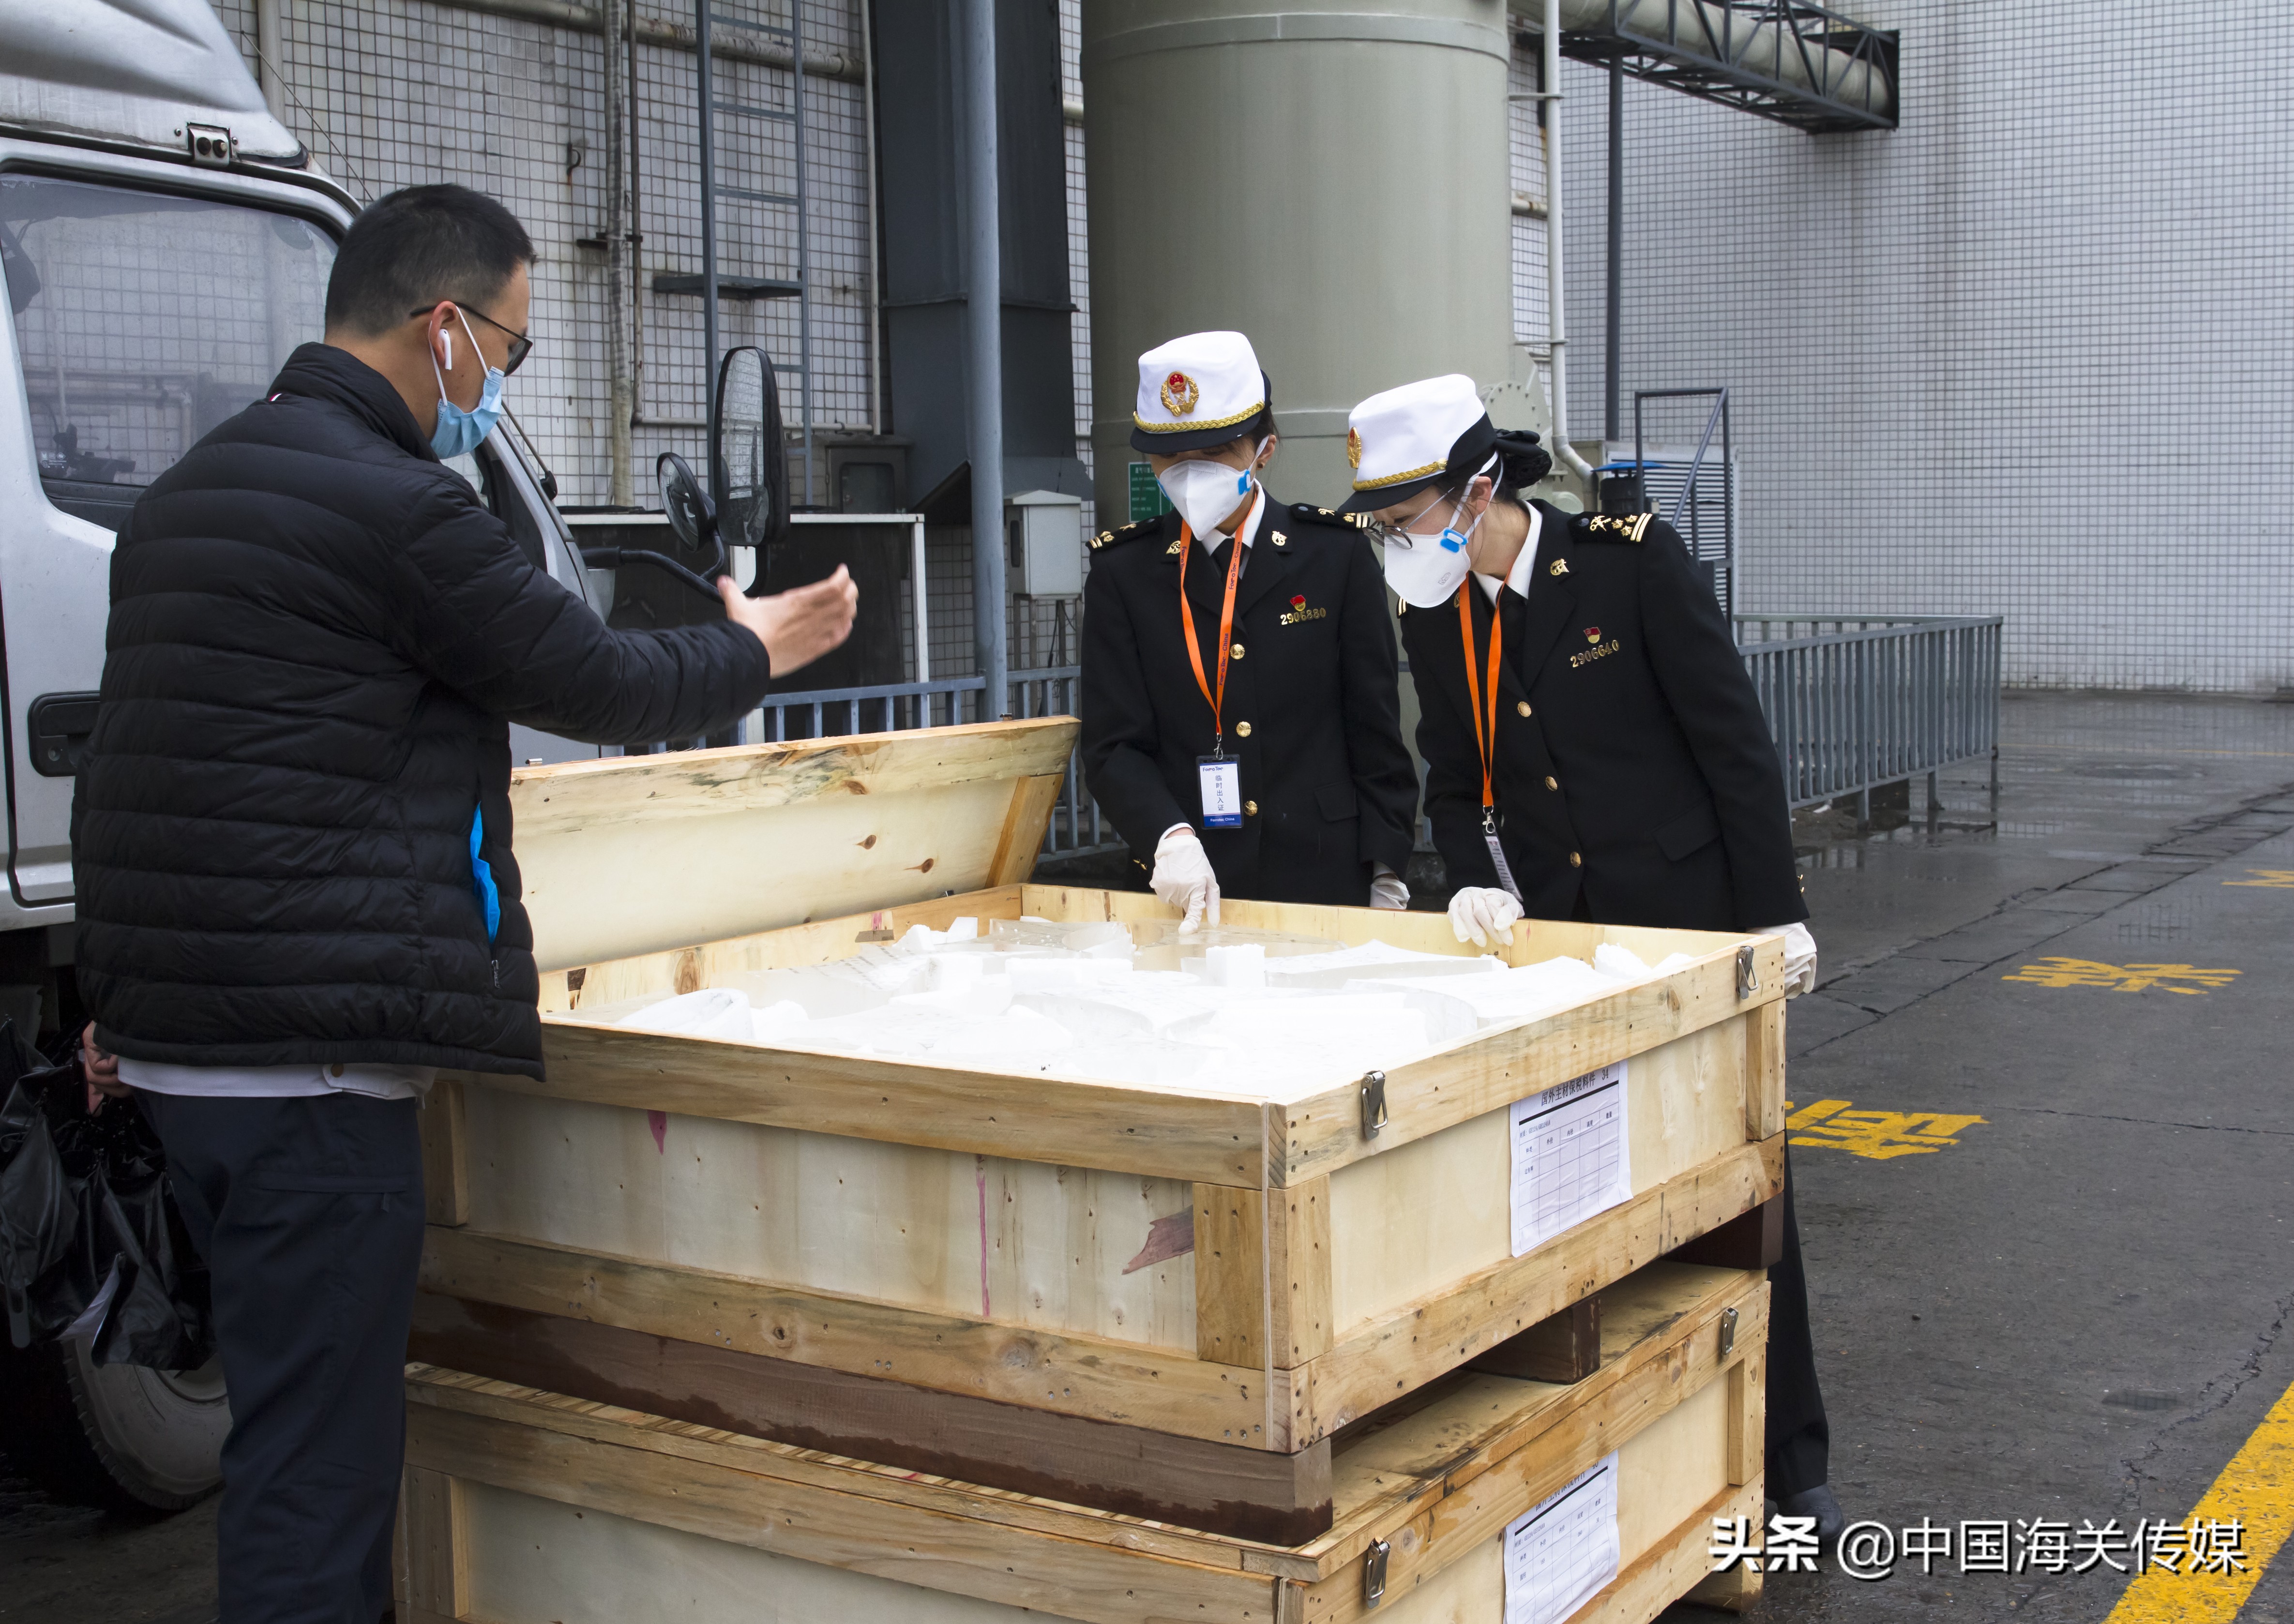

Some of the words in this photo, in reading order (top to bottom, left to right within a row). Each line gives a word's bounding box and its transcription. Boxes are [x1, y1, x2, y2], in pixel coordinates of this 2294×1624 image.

[1280, 607, 1326, 625] 2906880
[1570, 640, 1619, 668] 2906640
[1215, 775, 1224, 811] 临时出入证
[1541, 1072, 1596, 1107] 国外主材保税料件
[1601, 1068, 1609, 1080] 34
